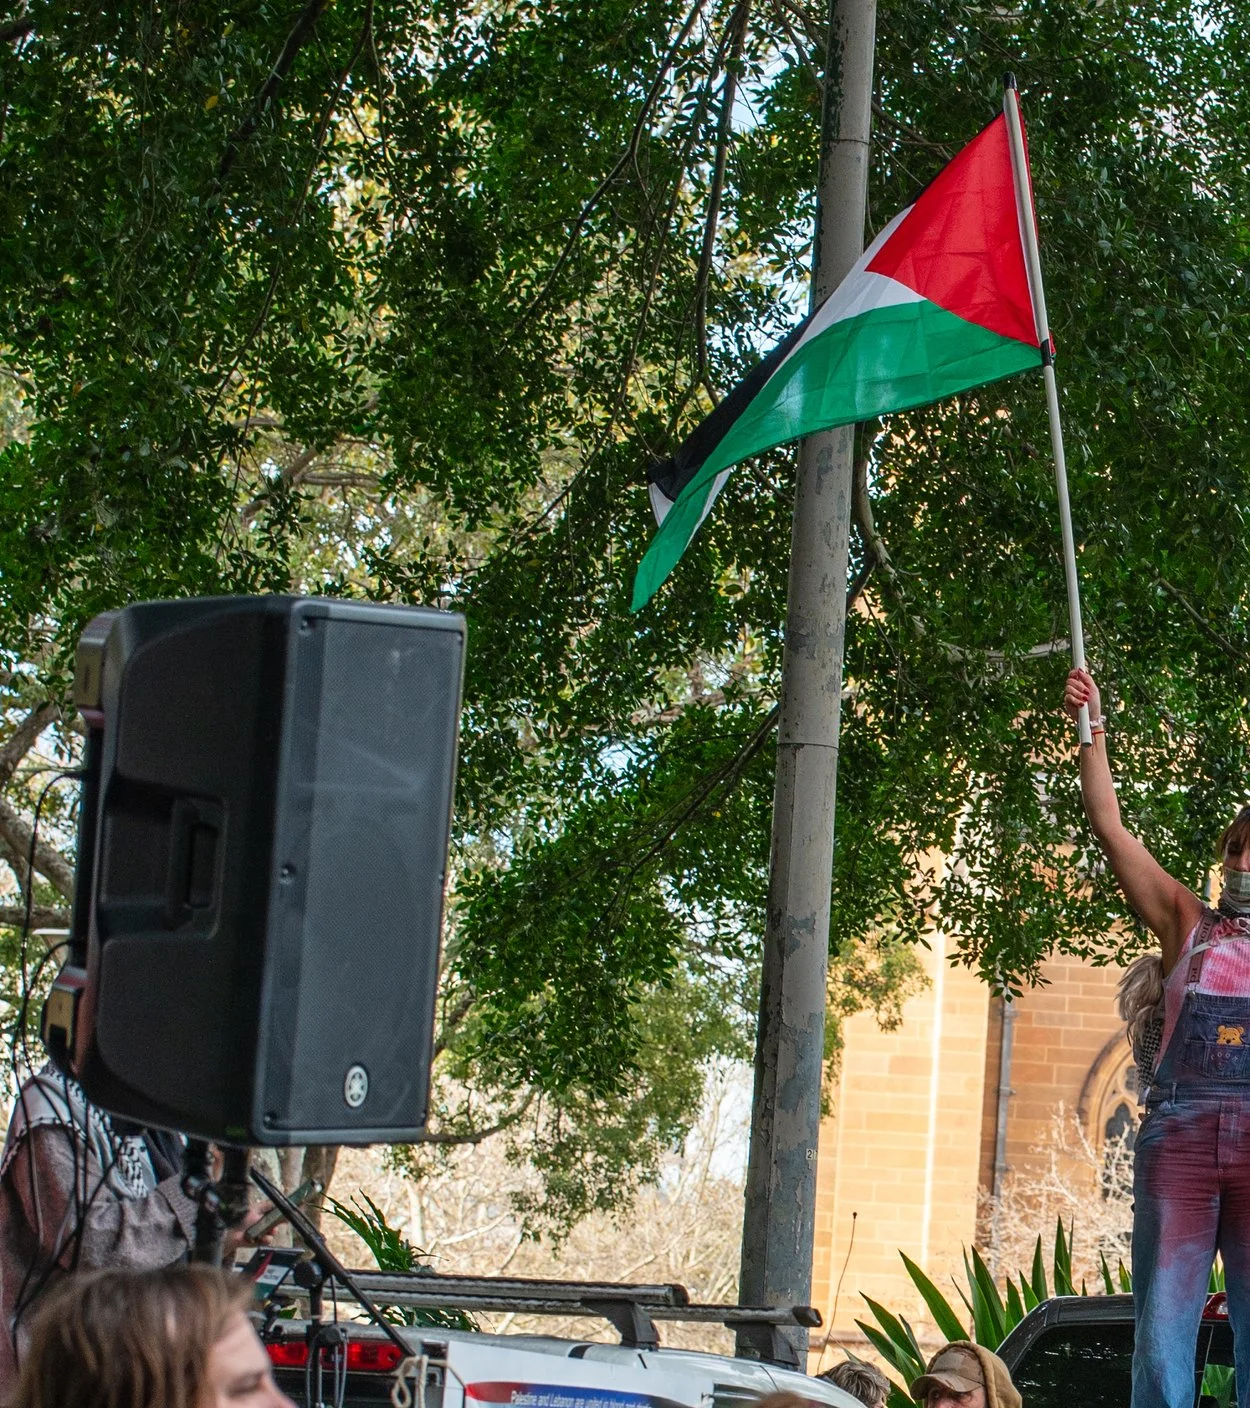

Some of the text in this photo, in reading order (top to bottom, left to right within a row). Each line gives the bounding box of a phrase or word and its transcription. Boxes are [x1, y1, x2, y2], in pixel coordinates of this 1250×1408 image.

[511, 1390, 537, 1406] Palestine
[538, 1393, 549, 1406] and
[549, 1393, 574, 1408] Lebanon
[575, 1398, 585, 1408] are
